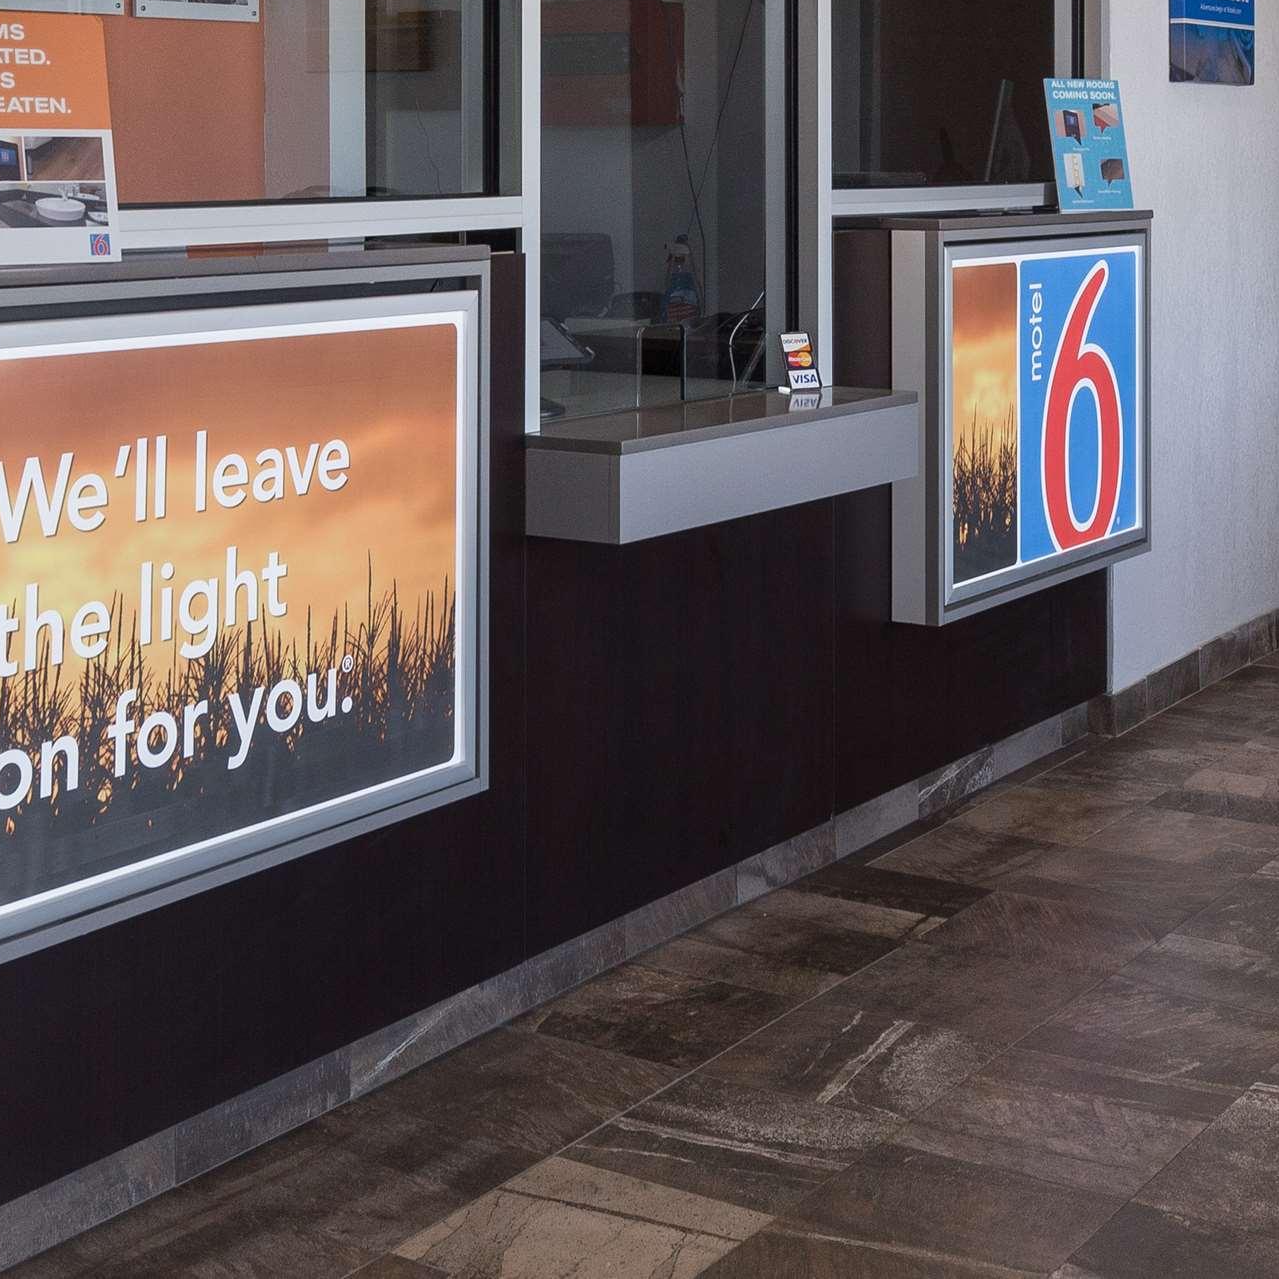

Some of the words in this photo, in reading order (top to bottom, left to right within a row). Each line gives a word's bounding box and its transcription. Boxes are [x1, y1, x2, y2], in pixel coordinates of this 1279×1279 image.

[1051, 80, 1065, 88] ALL
[1067, 80, 1084, 89] NEW
[1086, 80, 1115, 89] ROOMS
[1052, 91, 1088, 100] COMING
[1090, 91, 1116, 100] SOON.
[92, 233, 109, 255] 6
[1031, 282, 1042, 381] motel
[792, 374, 817, 384] VISA
[1041, 259, 1123, 551] 6
[195, 429, 351, 512] leave
[140, 546, 288, 661] light
[107, 687, 212, 779] for
